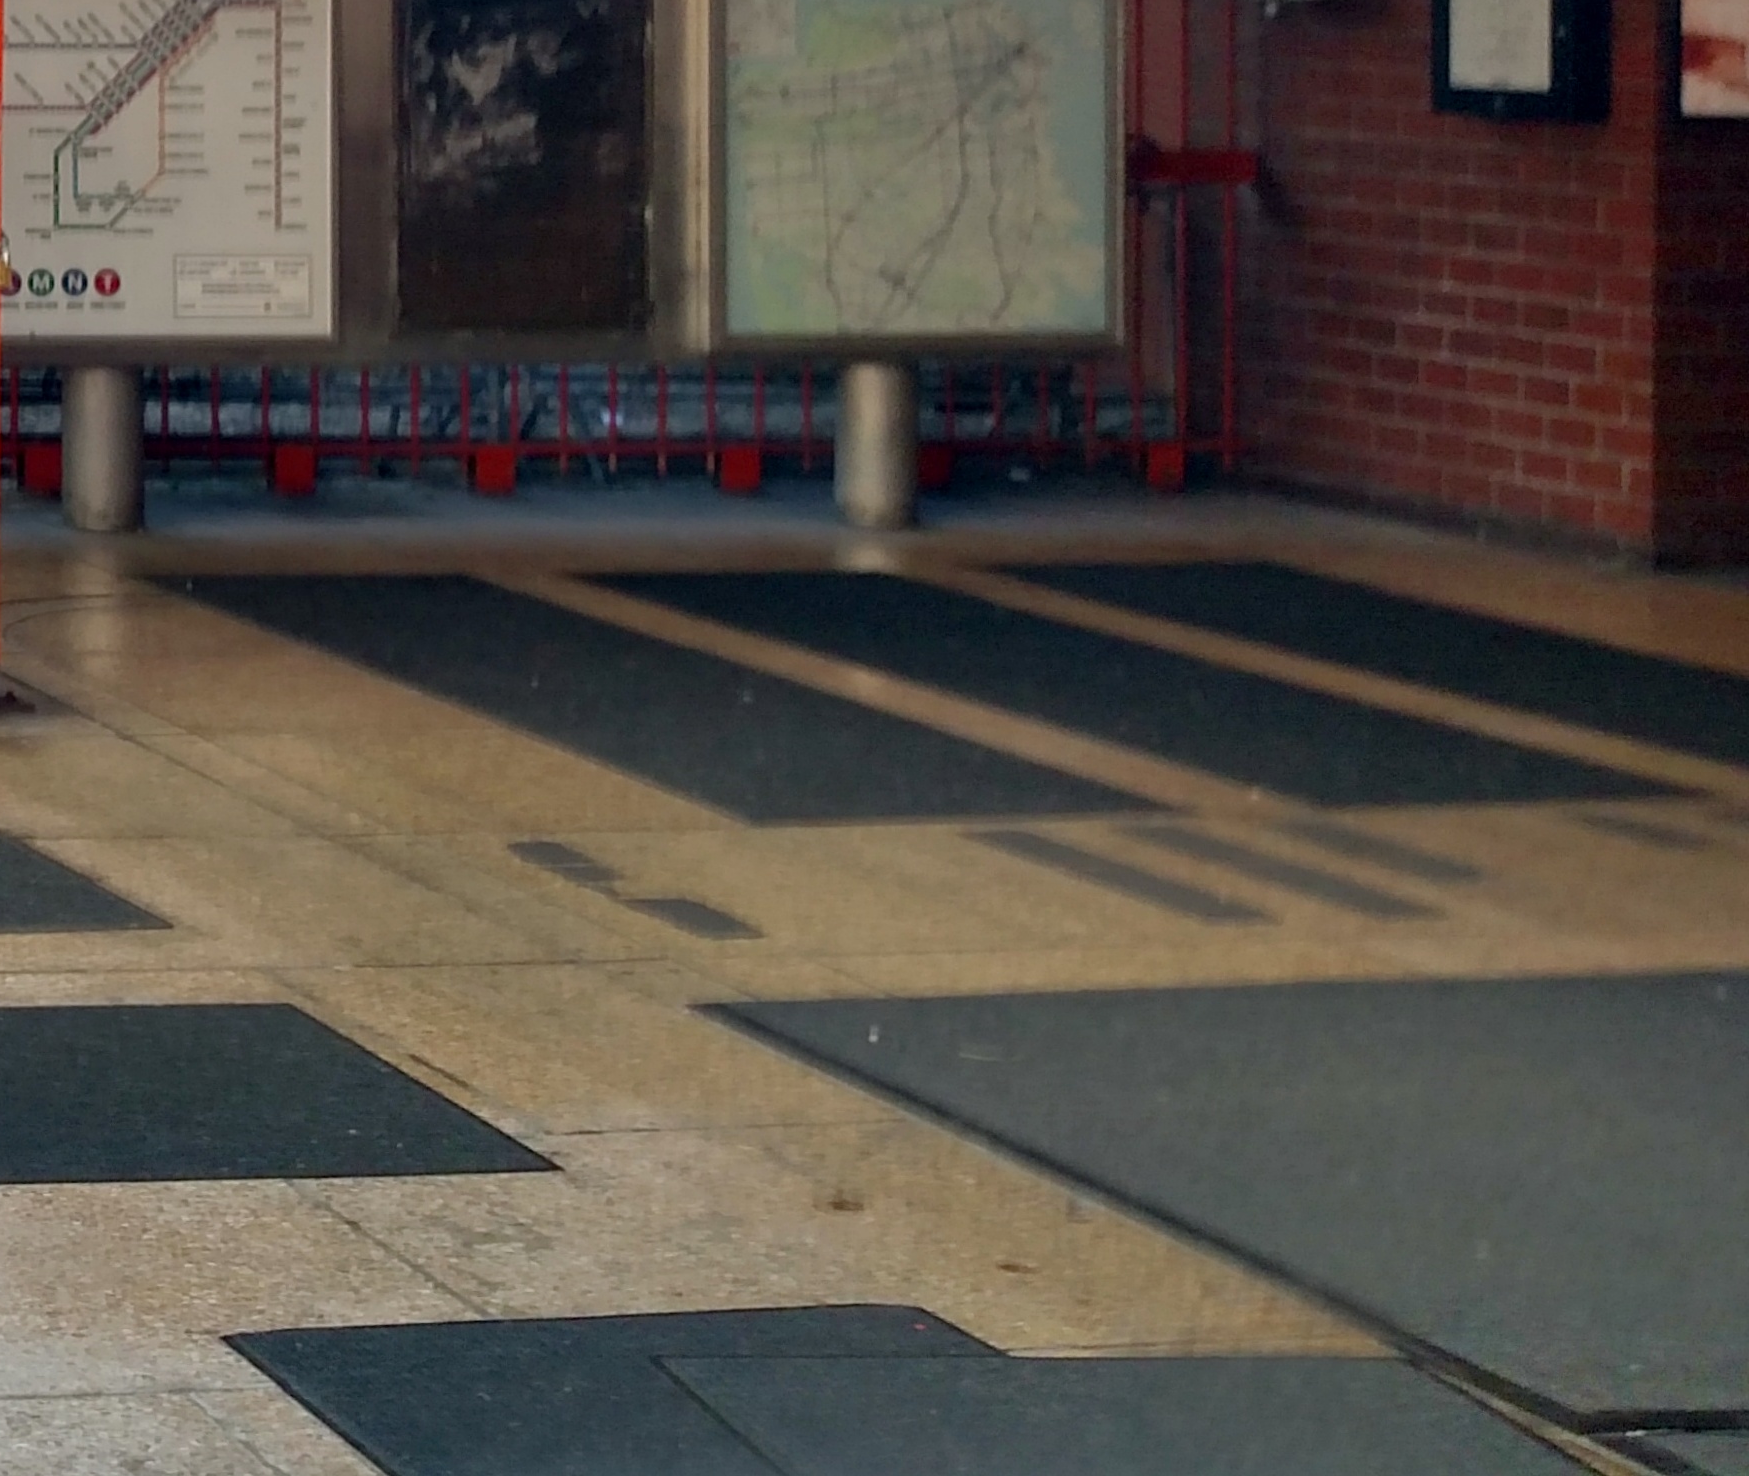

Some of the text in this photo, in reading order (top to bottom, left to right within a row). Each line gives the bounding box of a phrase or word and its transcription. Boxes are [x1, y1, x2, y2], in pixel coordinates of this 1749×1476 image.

[32, 272, 51, 291] M
[67, 272, 83, 291] N
[100, 273, 114, 293] T
